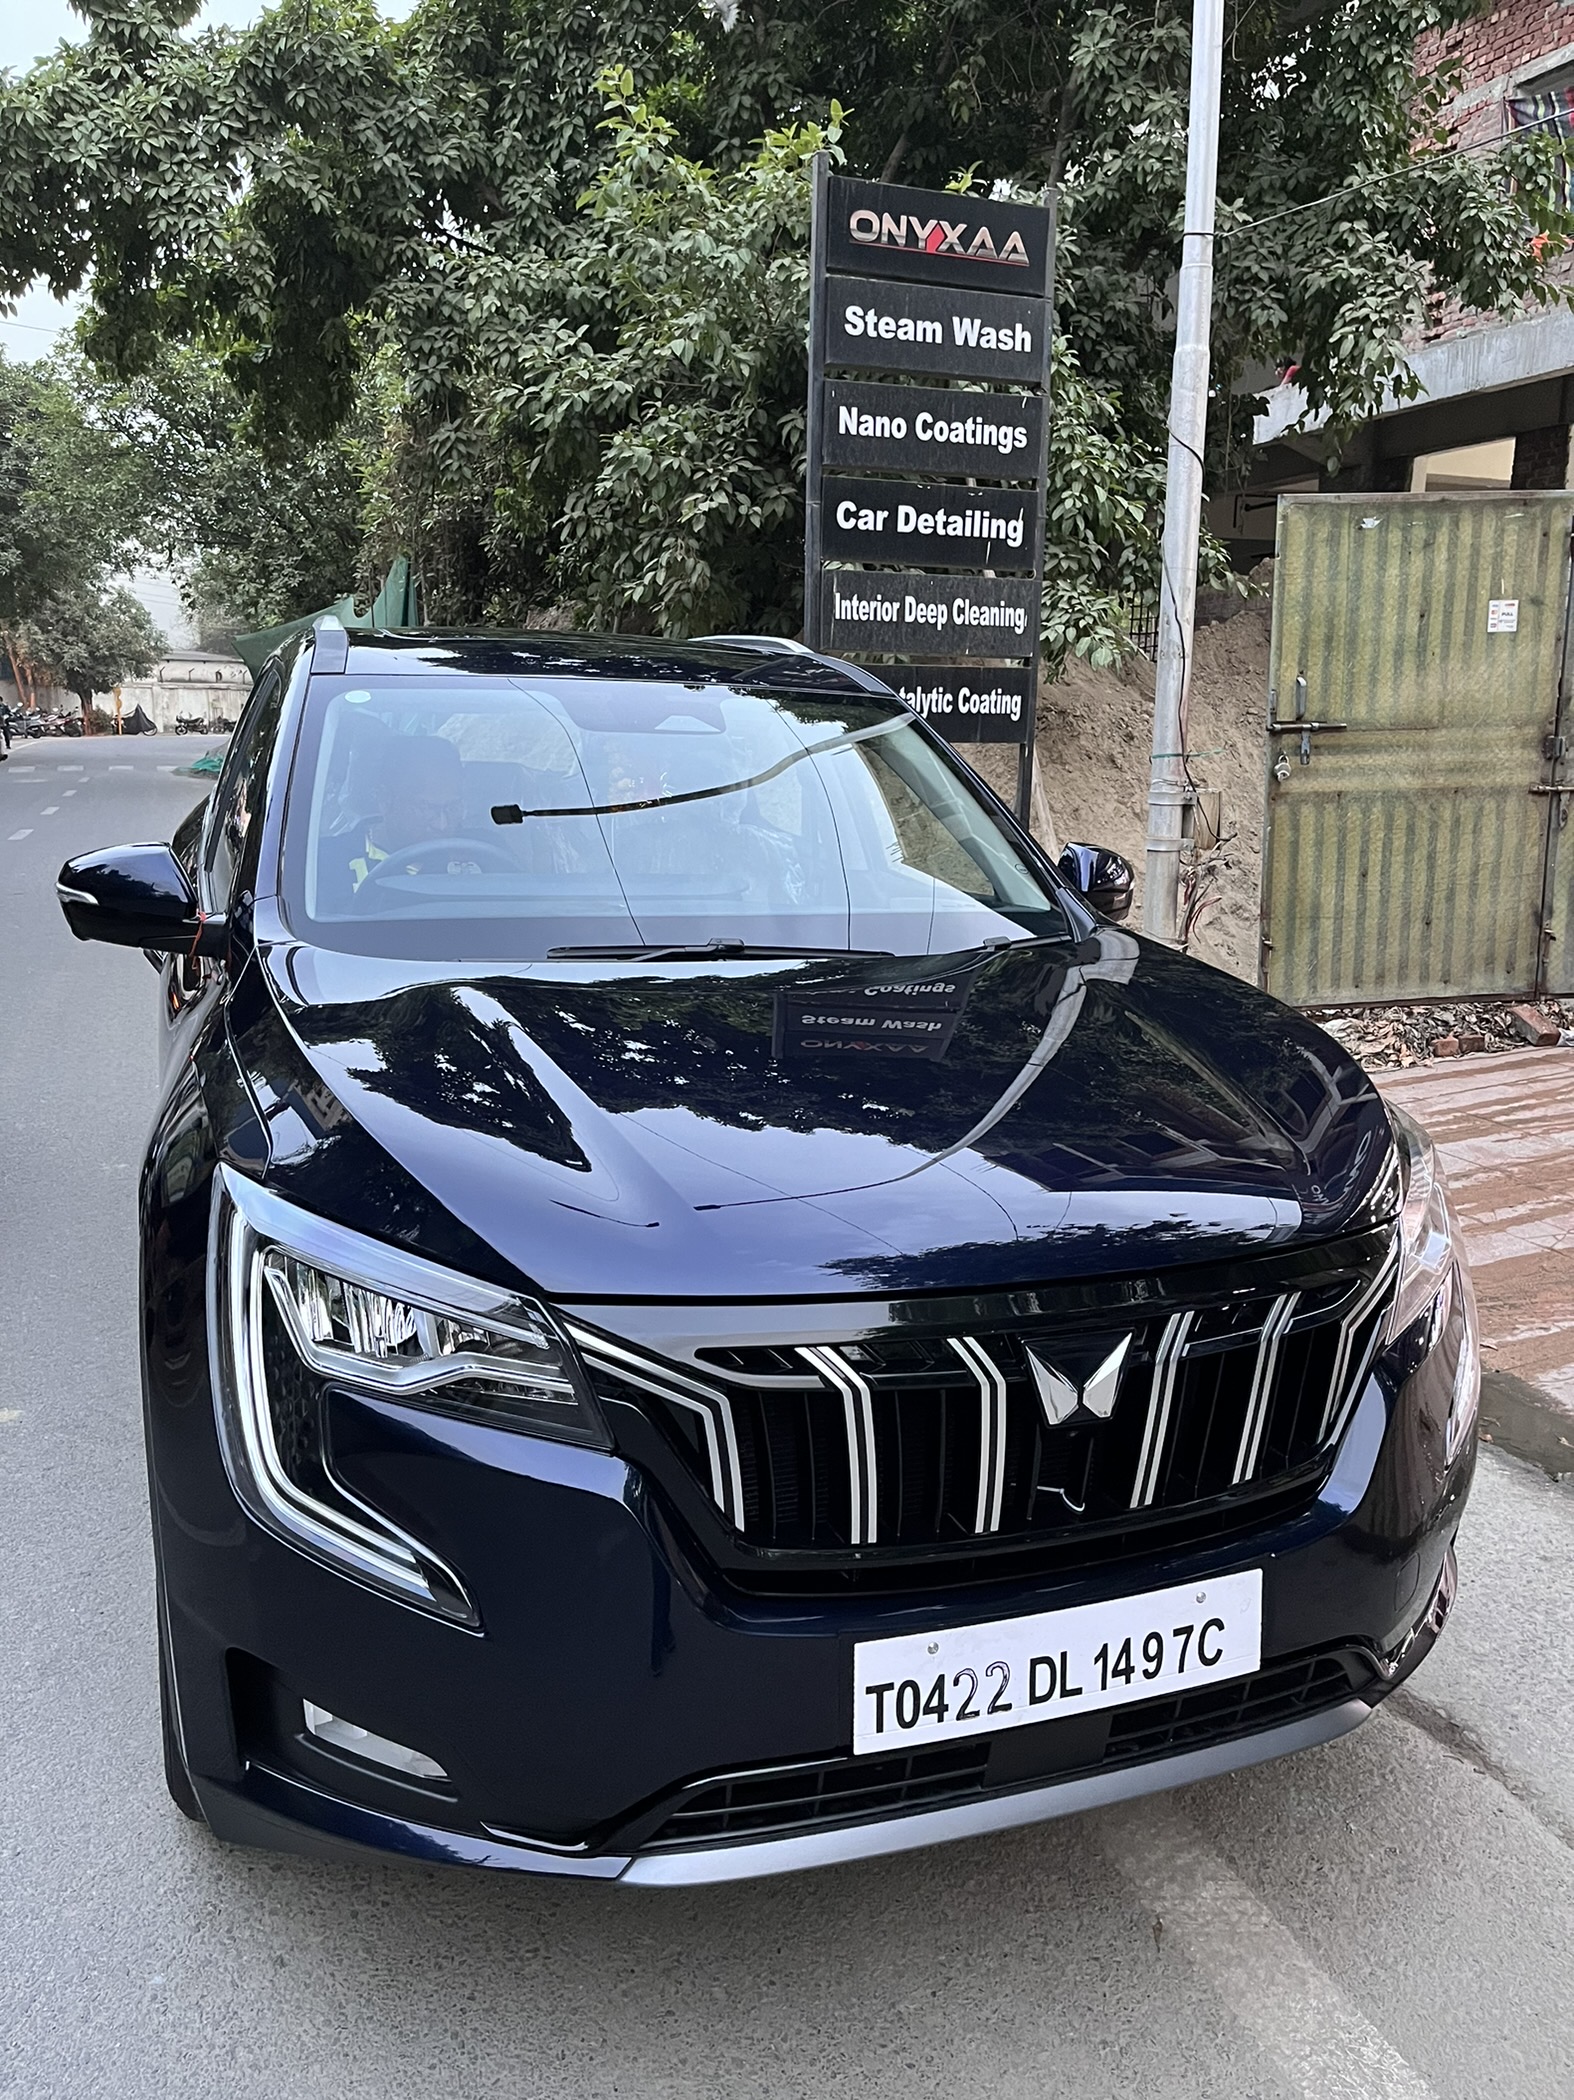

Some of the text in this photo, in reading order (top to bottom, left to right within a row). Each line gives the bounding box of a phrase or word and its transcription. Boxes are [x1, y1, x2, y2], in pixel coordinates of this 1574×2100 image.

[850, 210, 1030, 264] ONYXAA
[844, 305, 1032, 352] Steam Wash
[838, 406, 1027, 453] Nano Coatings
[836, 501, 1024, 547] Car Detailing
[835, 593, 1026, 634] Interior Deep Cleaning
[899, 686, 1022, 721] talytic Coating
[1028, 1651, 1083, 1705] DL
[1093, 1618, 1225, 1691] 1497C
